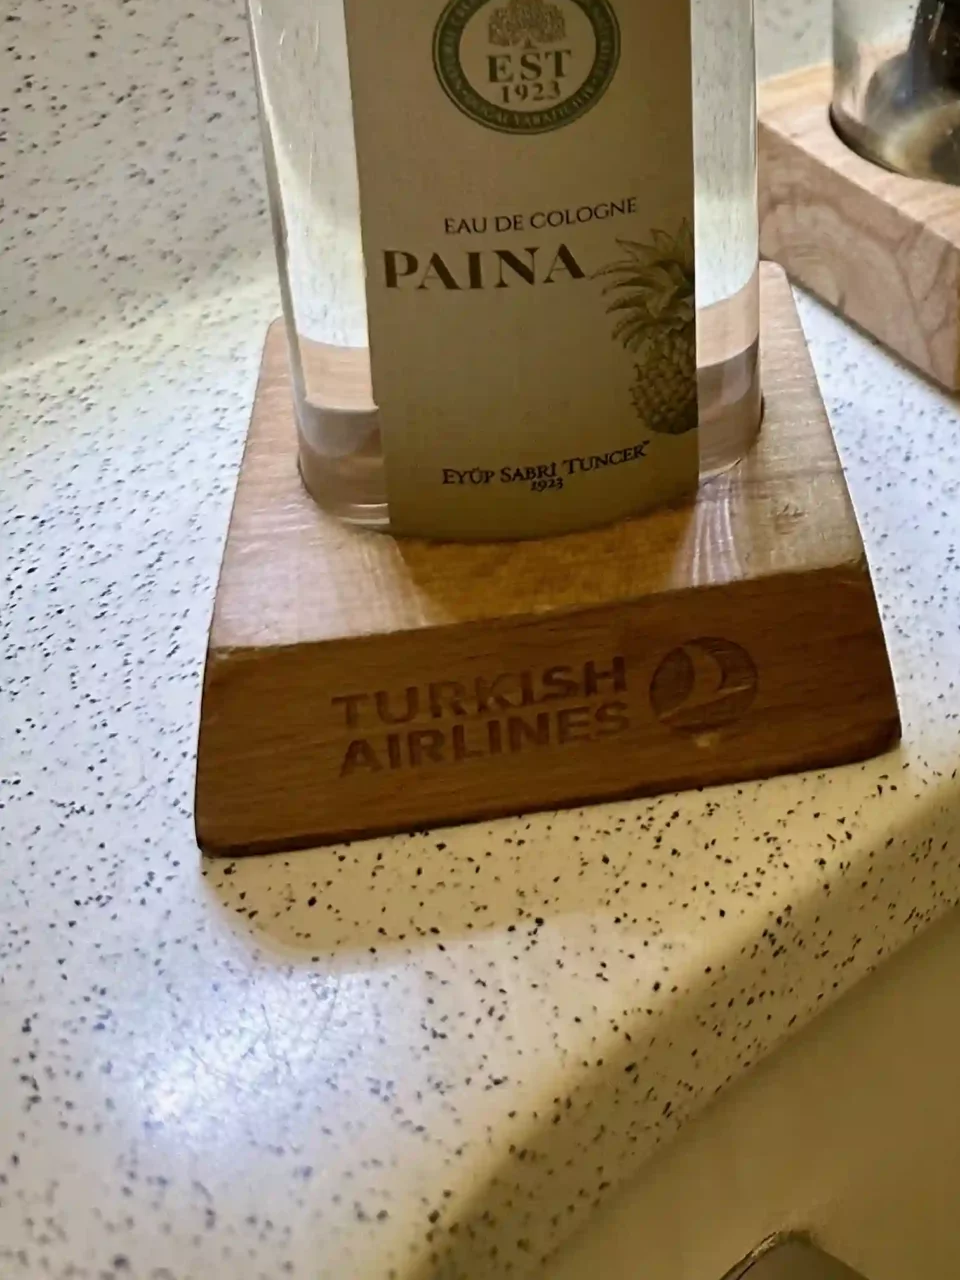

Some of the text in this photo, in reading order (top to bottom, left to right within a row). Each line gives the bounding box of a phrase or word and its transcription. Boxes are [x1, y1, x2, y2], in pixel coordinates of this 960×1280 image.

[486, 48, 571, 84] EST
[501, 80, 562, 104] 1923
[444, 197, 638, 236] EAU DE COLOGNE
[382, 242, 587, 291] PAINA
[531, 477, 564, 492] 1923
[331, 656, 628, 729] TURKISH
[339, 700, 631, 777] AIRLINES
